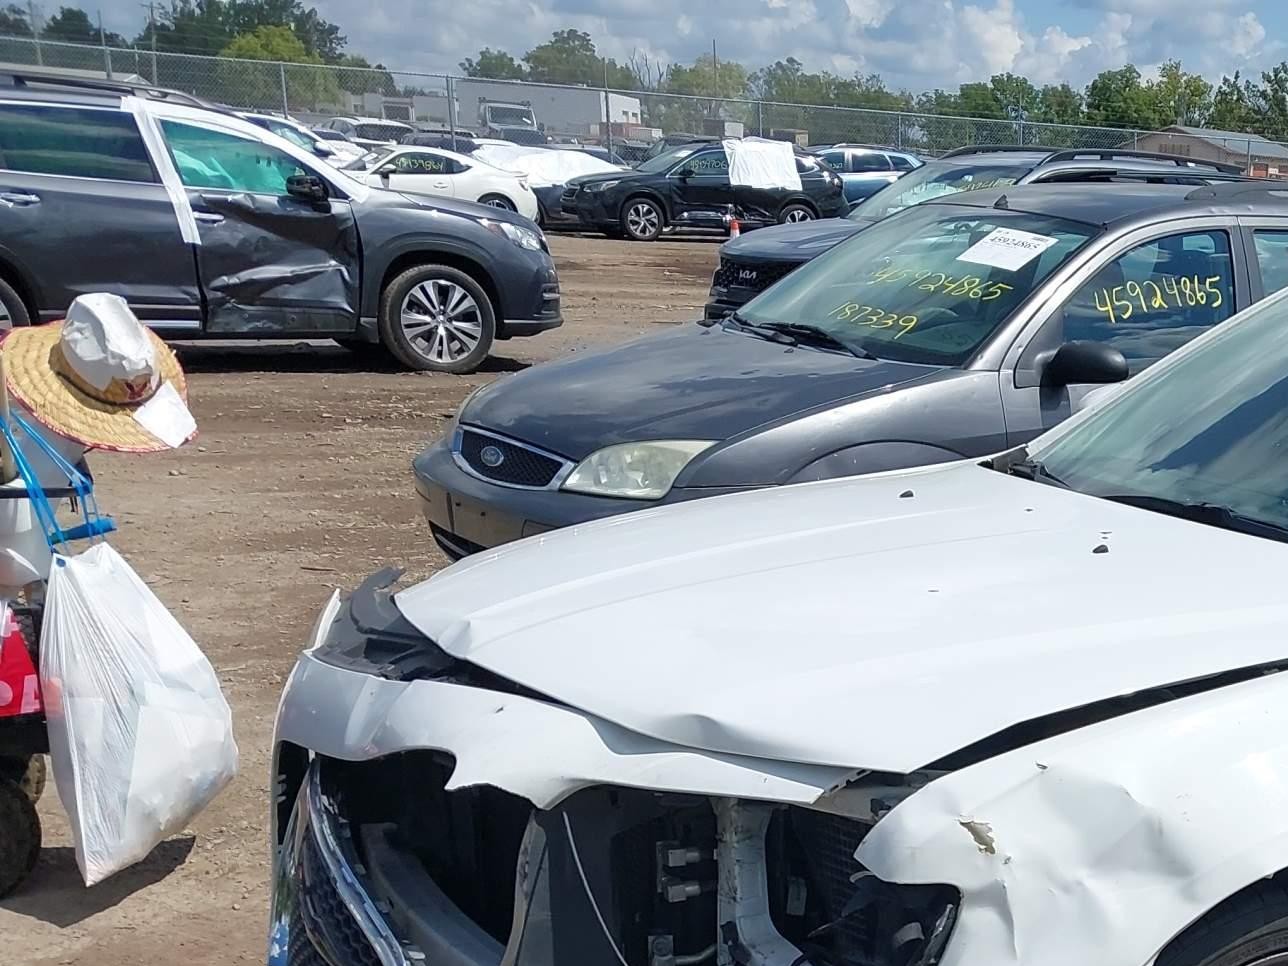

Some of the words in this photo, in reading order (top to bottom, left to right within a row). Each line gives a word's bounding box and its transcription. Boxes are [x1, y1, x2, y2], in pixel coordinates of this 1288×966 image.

[867, 269, 1014, 300] 45924865
[1094, 274, 1222, 323] 45924865
[828, 302, 918, 340] 187339
